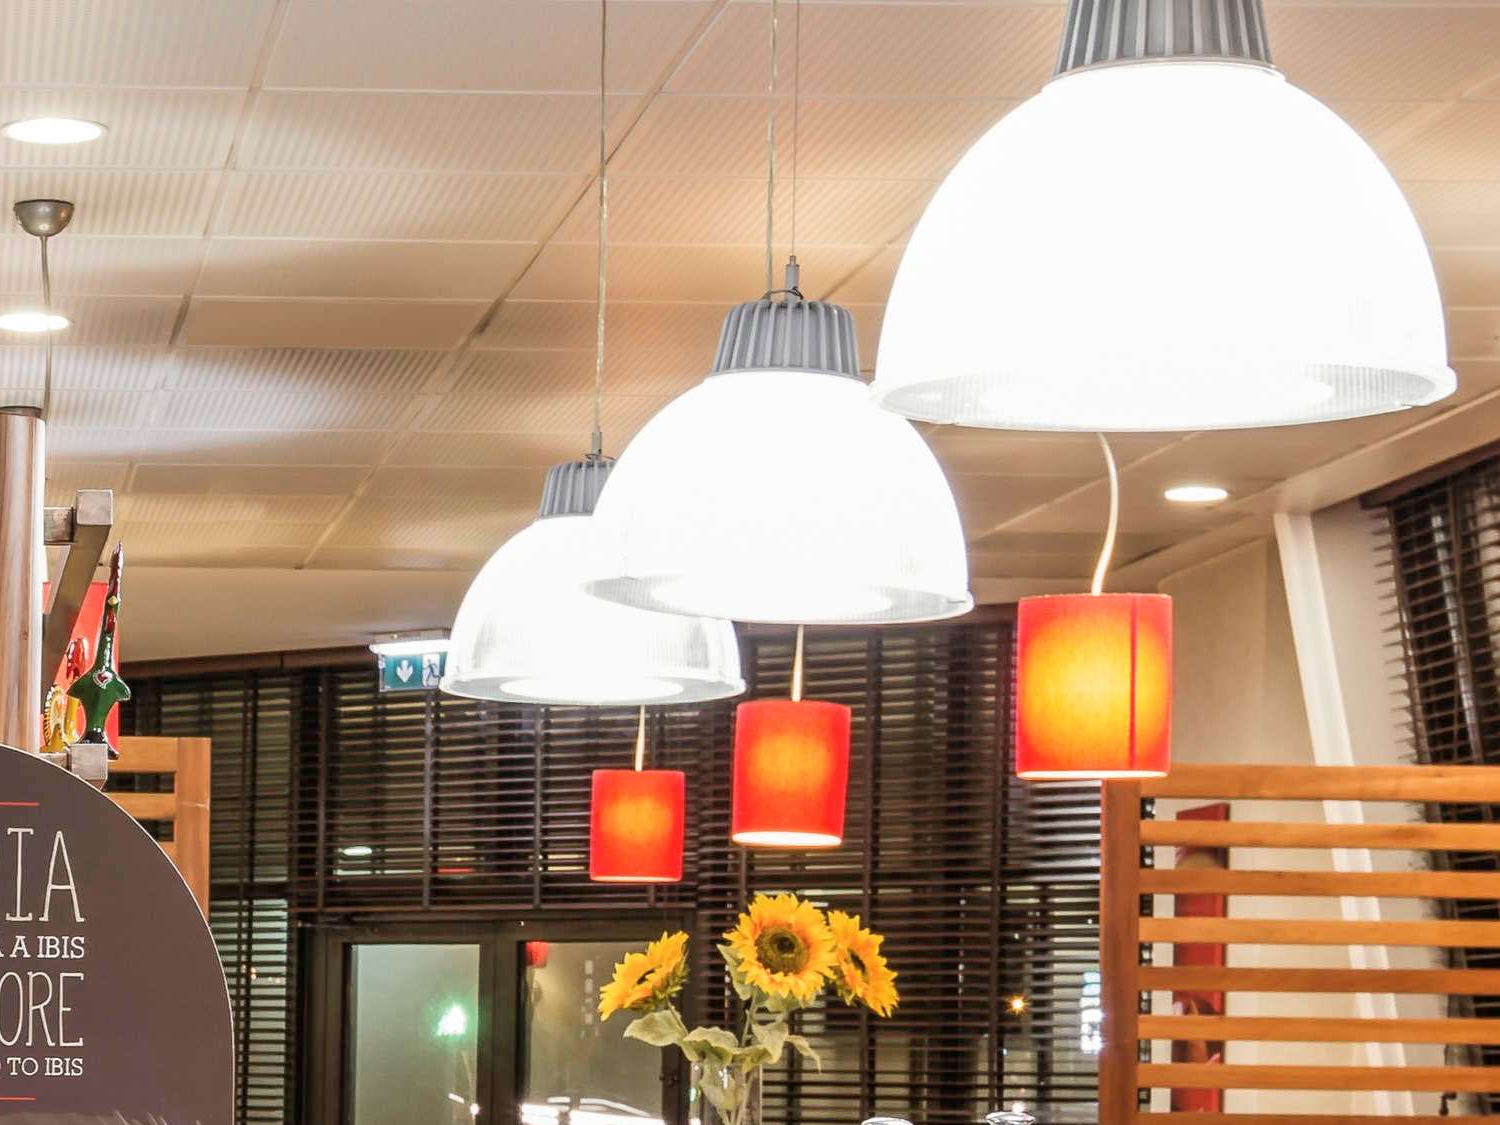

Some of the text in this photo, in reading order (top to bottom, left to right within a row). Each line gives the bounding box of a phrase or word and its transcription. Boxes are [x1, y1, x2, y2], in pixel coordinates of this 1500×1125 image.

[10, 936, 30, 957] A
[37, 936, 84, 958] IBIS
[7, 1058, 38, 1075] TO
[45, 1058, 83, 1076] IBIS
